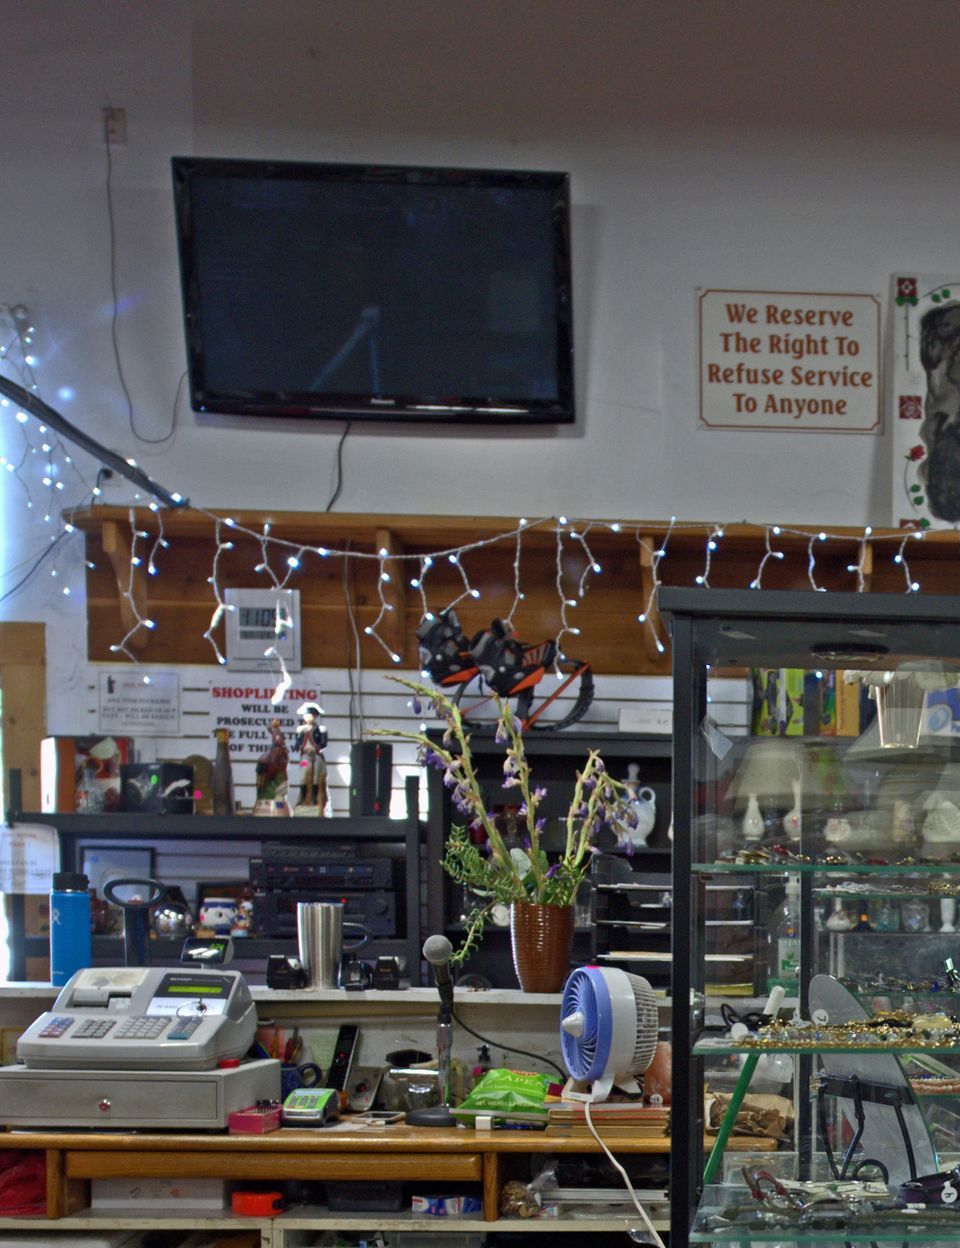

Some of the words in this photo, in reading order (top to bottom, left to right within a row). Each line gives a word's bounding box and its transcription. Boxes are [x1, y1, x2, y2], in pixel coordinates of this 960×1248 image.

[725, 303, 758, 324] We
[766, 304, 854, 326] Reserve
[719, 331, 761, 353] The
[769, 333, 829, 359] Right
[834, 336, 860, 356] To
[707, 363, 784, 385] Refuse
[791, 366, 873, 388] Service
[732, 393, 757, 413] To
[764, 394, 847, 419] Anyone
[212, 687, 318, 700] SHOPLIFING
[241, 704, 271, 713] WILL
[273, 704, 289, 714] BE
[217, 717, 295, 727] PROSECUED
[239, 730, 268, 739] FULL
[230, 744, 245, 752] OF
